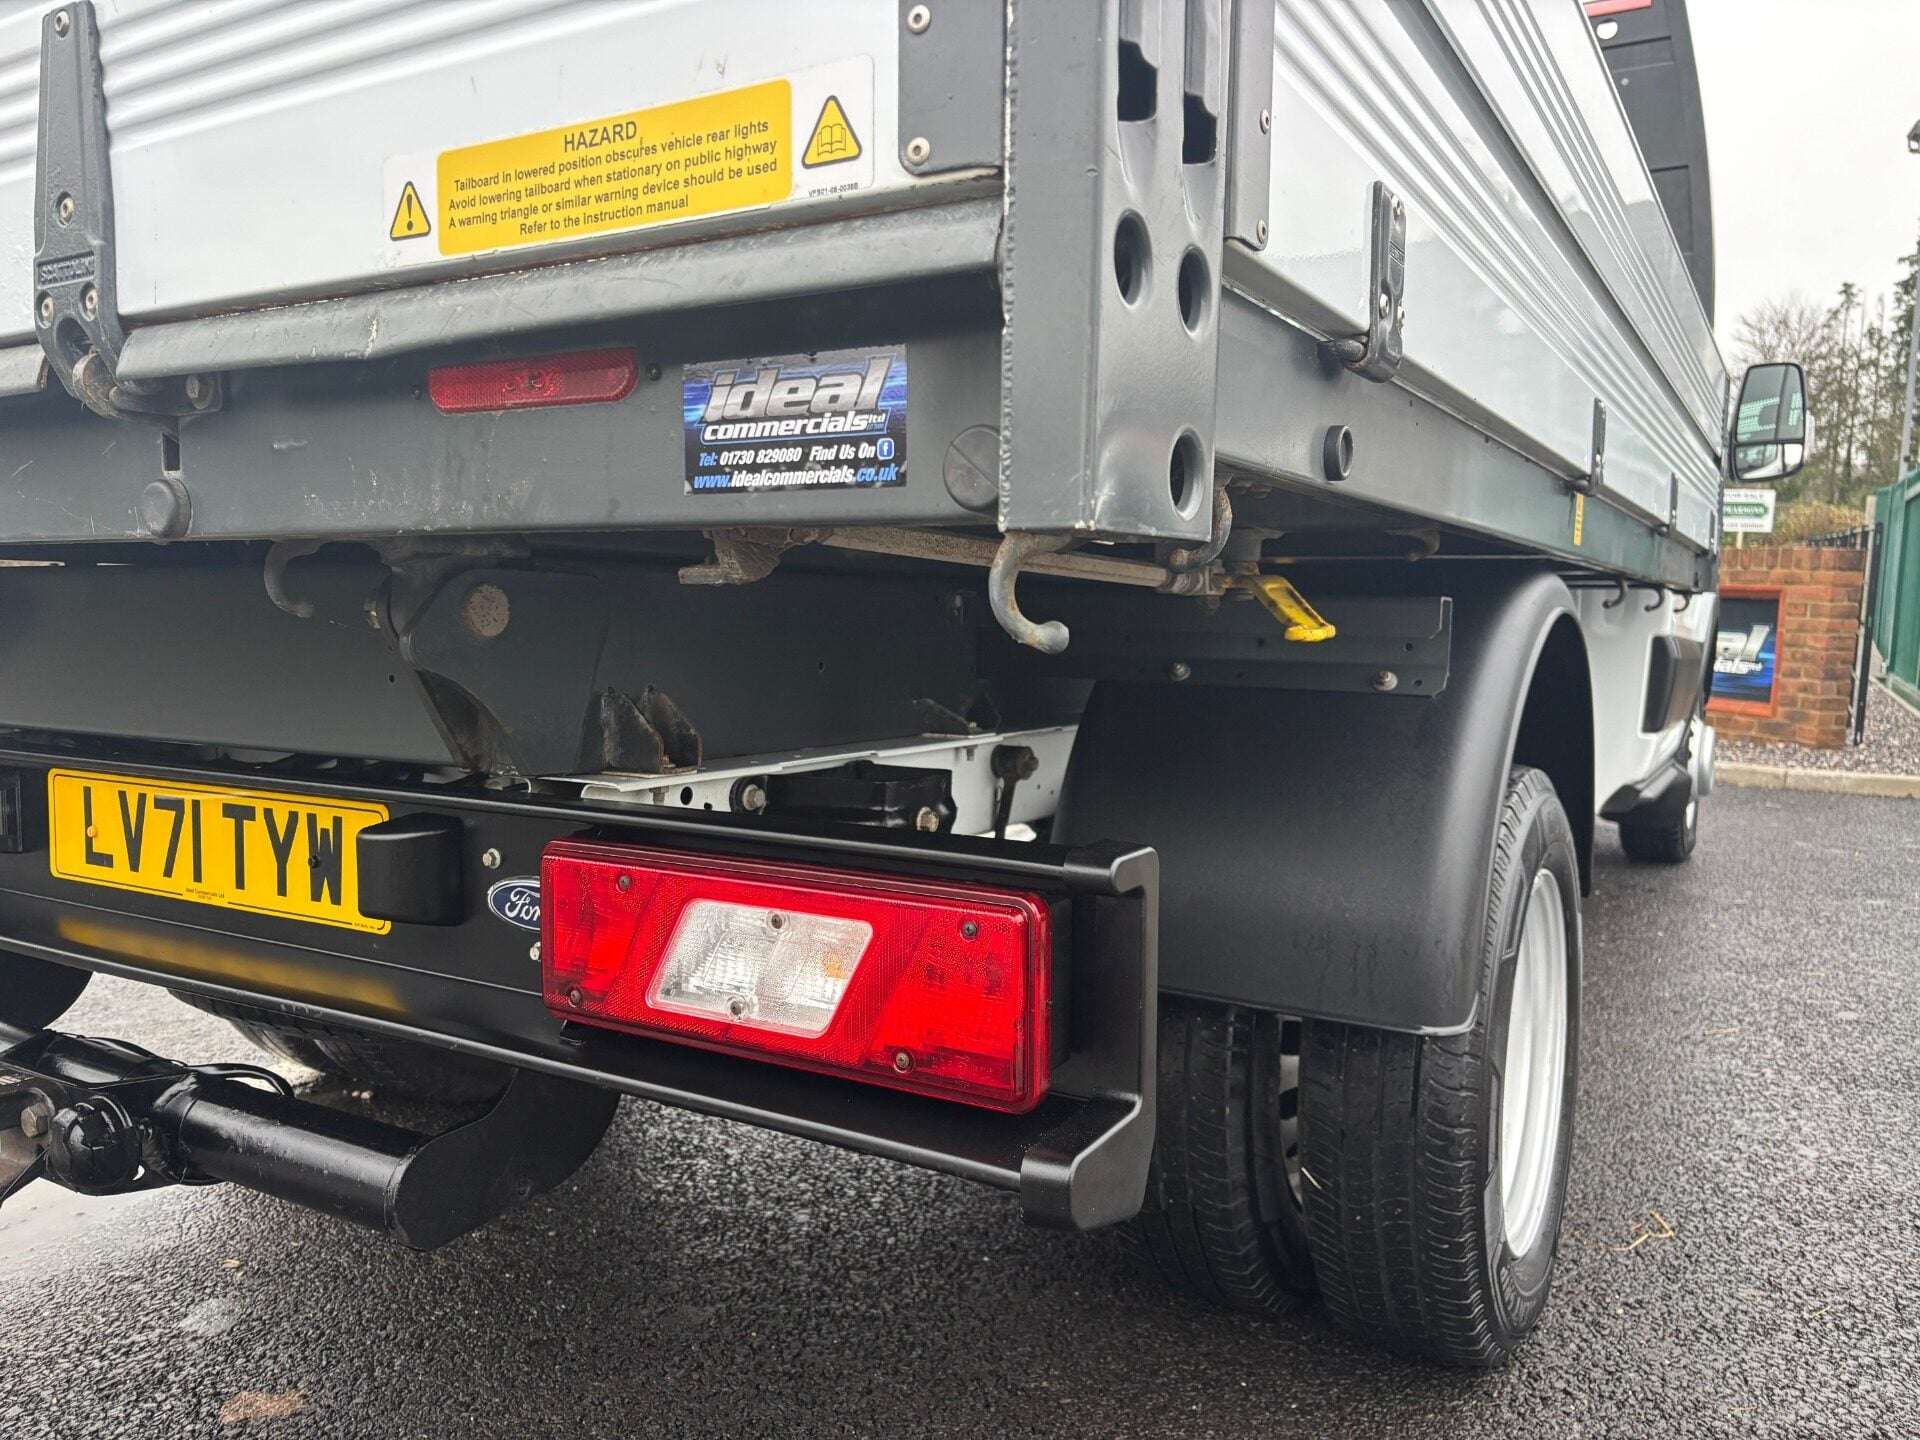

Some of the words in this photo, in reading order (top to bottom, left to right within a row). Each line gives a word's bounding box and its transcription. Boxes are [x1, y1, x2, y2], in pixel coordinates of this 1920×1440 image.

[454, 173, 500, 192] Tailboard
[502, 171, 512, 184] in
[514, 162, 555, 181] lowered
[558, 154, 602, 177] position
[605, 143, 658, 163] obscures
[661, 132, 703, 152] vehicle
[706, 128, 730, 143] rear
[734, 120, 769, 139] lights
[564, 120, 638, 153] HAZARD
[449, 197, 476, 211] Avoid
[479, 188, 522, 206] lowering
[524, 178, 571, 198] tailboard
[573, 172, 603, 189] when
[605, 162, 663, 183] stationary
[666, 159, 681, 171] on
[684, 150, 721, 170] public
[724, 140, 777, 160] highway
[449, 217, 457, 229] A
[457, 211, 498, 226] warning
[500, 203, 539, 221] triangle
[541, 202, 553, 213] or
[555, 193, 592, 211] similar
[594, 186, 639, 204] warning
[642, 178, 680, 196] device
[683, 168, 724, 188] should
[728, 164, 743, 180] be
[746, 158, 777, 176] used
[519, 222, 547, 236] Refer
[550, 219, 560, 230] to
[563, 214, 580, 229] the
[583, 201, 643, 225] instruction
[646, 194, 689, 213] manual
[702, 355, 894, 423] ideal
[703, 411, 868, 441] commercials
[693, 462, 899, 489] www.idealcommercials.co.uk
[699, 452, 718, 467] Tel:
[719, 449, 753, 467] 01730
[756, 447, 803, 464] 829080
[809, 444, 836, 462] Find
[838, 443, 856, 460] Us
[858, 442, 876, 459] On
[83, 785, 203, 884] LV71
[221, 801, 343, 906] TYW
[505, 887, 540, 921] For
